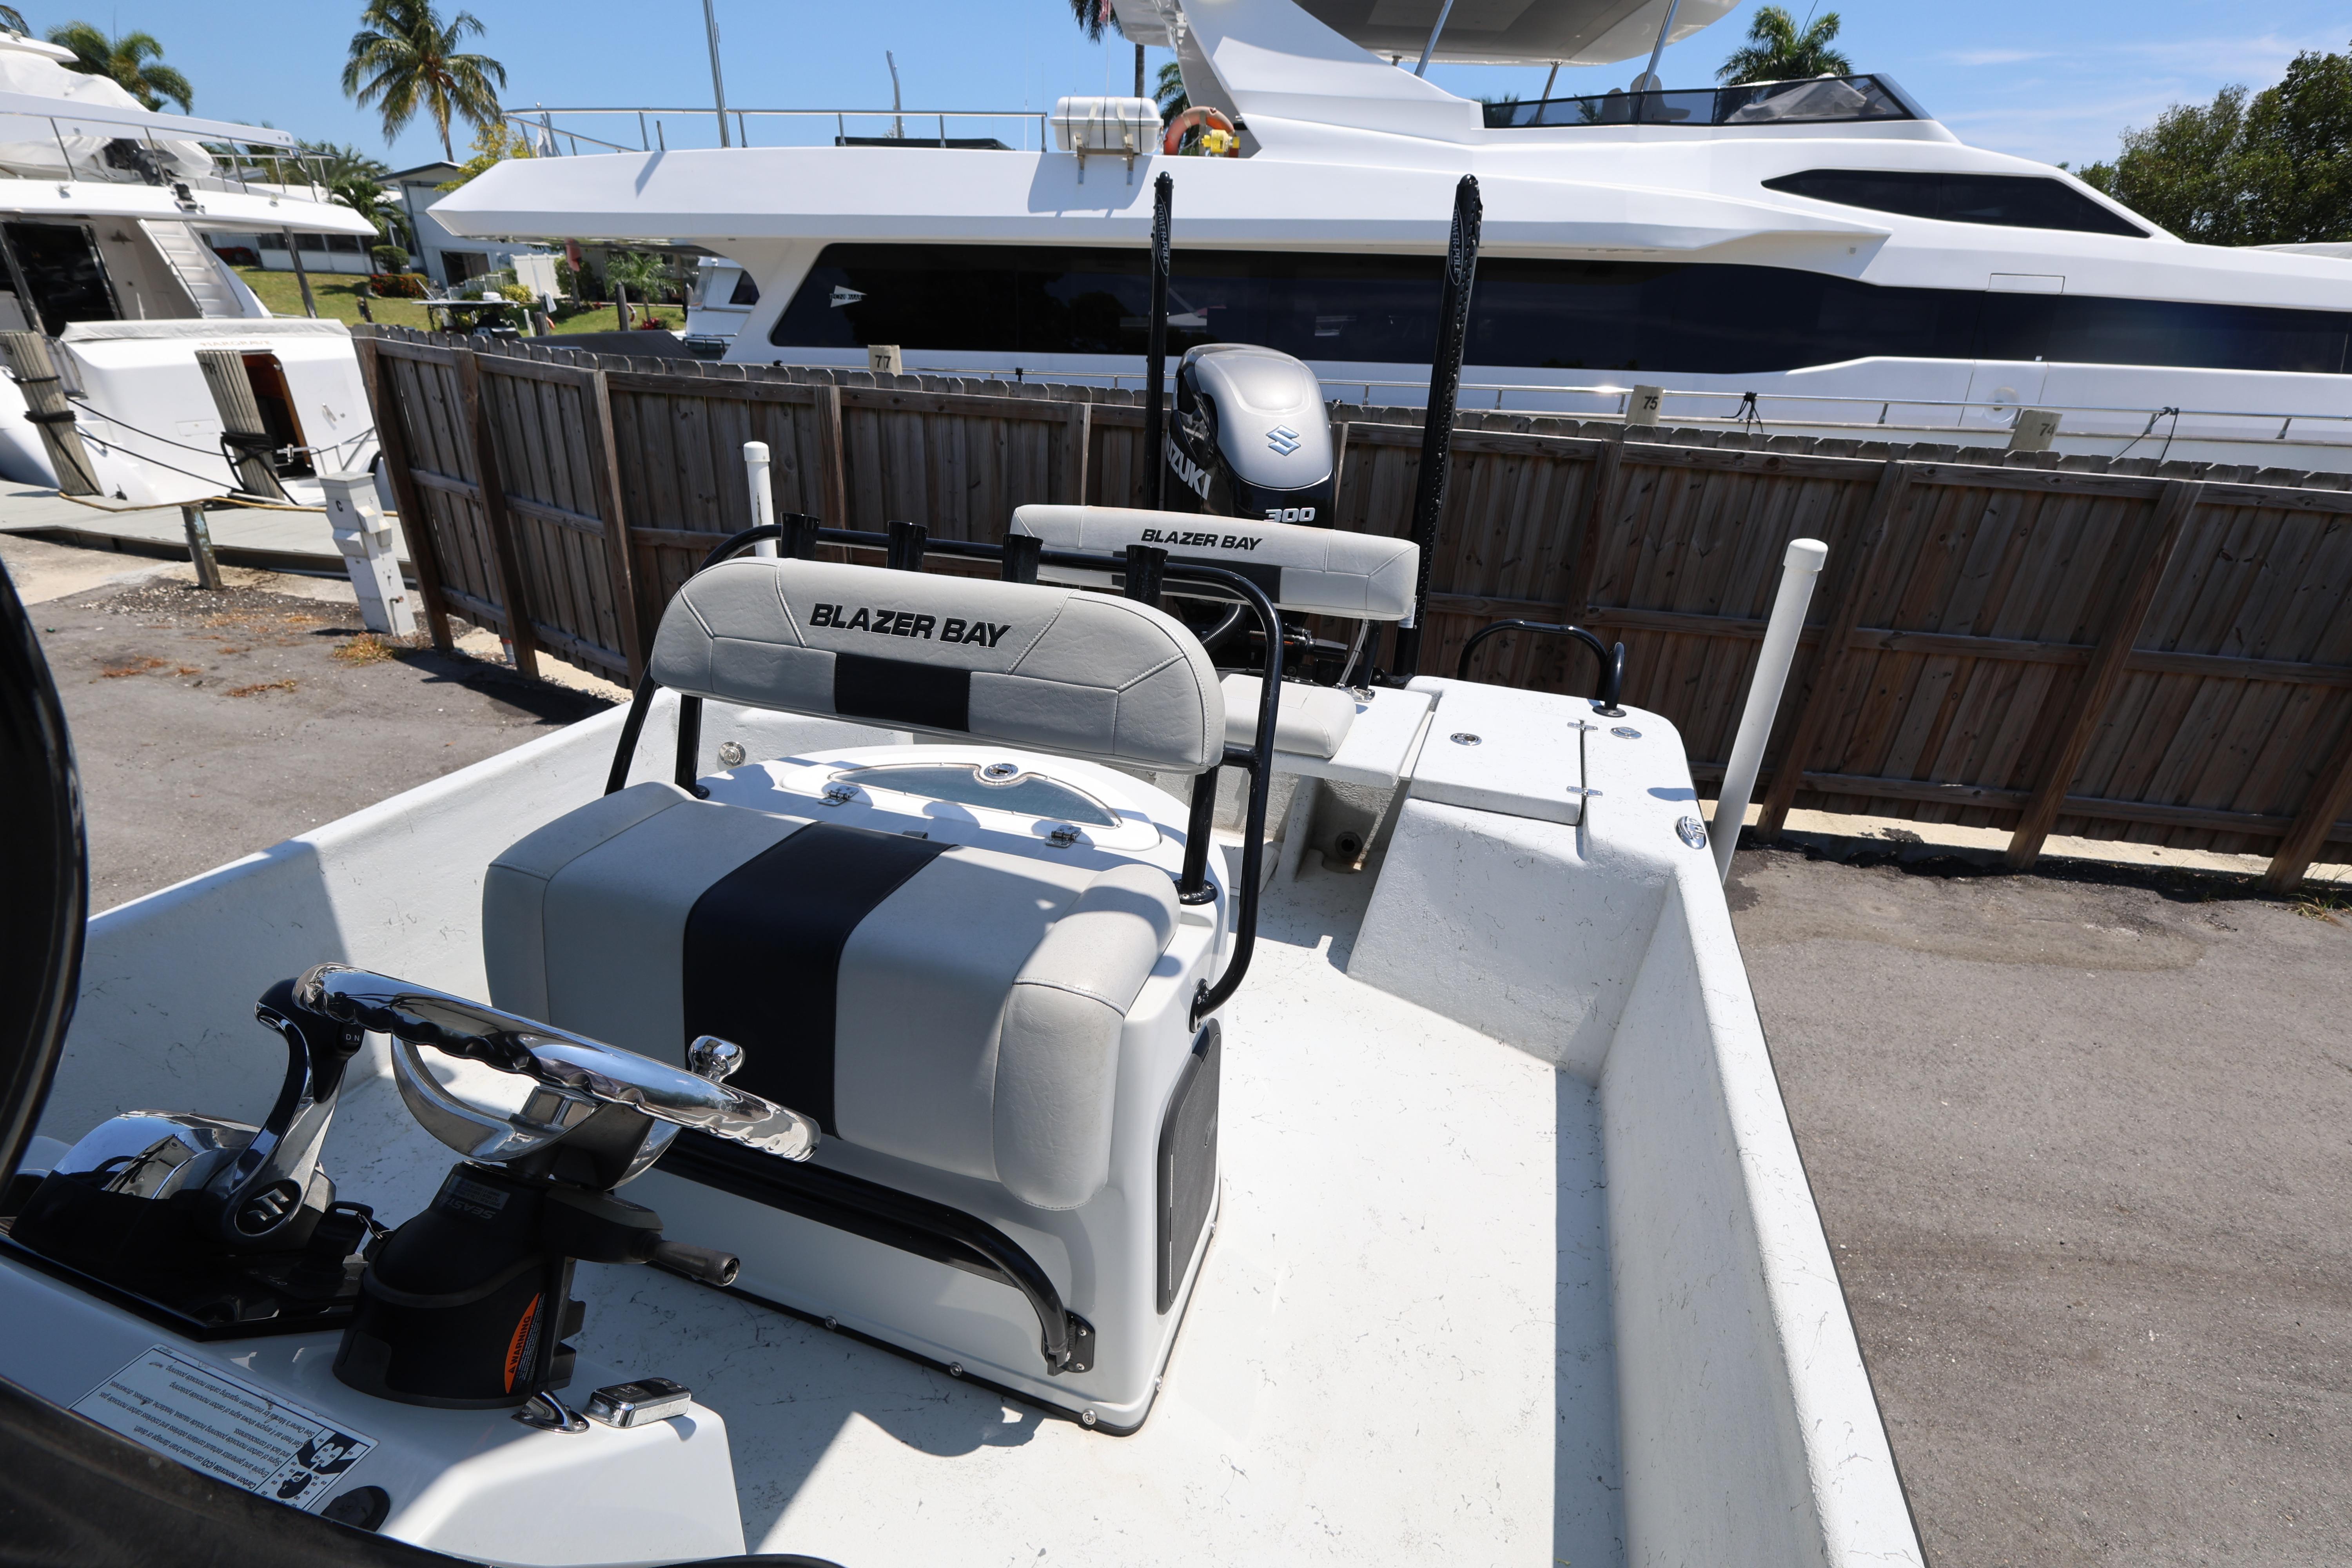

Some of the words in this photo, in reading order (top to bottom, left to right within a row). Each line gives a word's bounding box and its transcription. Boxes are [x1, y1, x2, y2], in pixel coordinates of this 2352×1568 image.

[1157, 203, 1169, 265] POWER-POLE
[875, 355, 891, 368] 77
[1643, 396, 1659, 410] 75
[2040, 423, 2056, 436] 74
[1166, 427, 1211, 500] UZUKI
[336, 500, 343, 512] C
[1263, 507, 1316, 523] 300
[1141, 528, 1219, 548] BLAZER
[1220, 535, 1263, 551] BAY
[809, 603, 936, 640] BLAZER
[939, 617, 1012, 649] BAY
[510, 1316, 531, 1365] WARNING
[185, 1375, 207, 1386] monoxide
[204, 1383, 221, 1393] carbon
[189, 1391, 211, 1404] monoxide
[219, 1389, 241, 1402] regarding
[107, 1396, 129, 1408] monoxide
[208, 1401, 225, 1410] carbon
[238, 1399, 264, 1414] information
[126, 1405, 143, 1415] carbon
[228, 1410, 242, 1419] signs
[140, 1412, 161, 1424] colorless
[240, 1415, 256, 1425] shows
[189, 1419, 207, 1430] include
[254, 1422, 273, 1432] anyone
[285, 1420, 305, 1433] Owner's
[167, 1425, 188, 1437] odorless
[204, 1425, 229, 1439] poisoning
[303, 1429, 315, 1437] See
[151, 1434, 171, 1446] damage
[185, 1434, 206, 1446] contains
[225, 1436, 249, 1449] monoxide
[280, 1434, 294, 1444] fresh
[291, 1439, 303, 1448] Get
[168, 1443, 182, 1452] brain
[180, 1448, 195, 1458] cause
[202, 1442, 223, 1454] exhaust
[246, 1446, 264, 1457] carbon
[269, 1445, 282, 1455] lack
[200, 1457, 216, 1469] (CO)
[220, 1451, 246, 1465] generator
[267, 1456, 282, 1466] Signs
[212, 1464, 239, 1479] monoxide
[250, 1465, 270, 1478] Engine
[236, 1476, 256, 1489] Carbon
